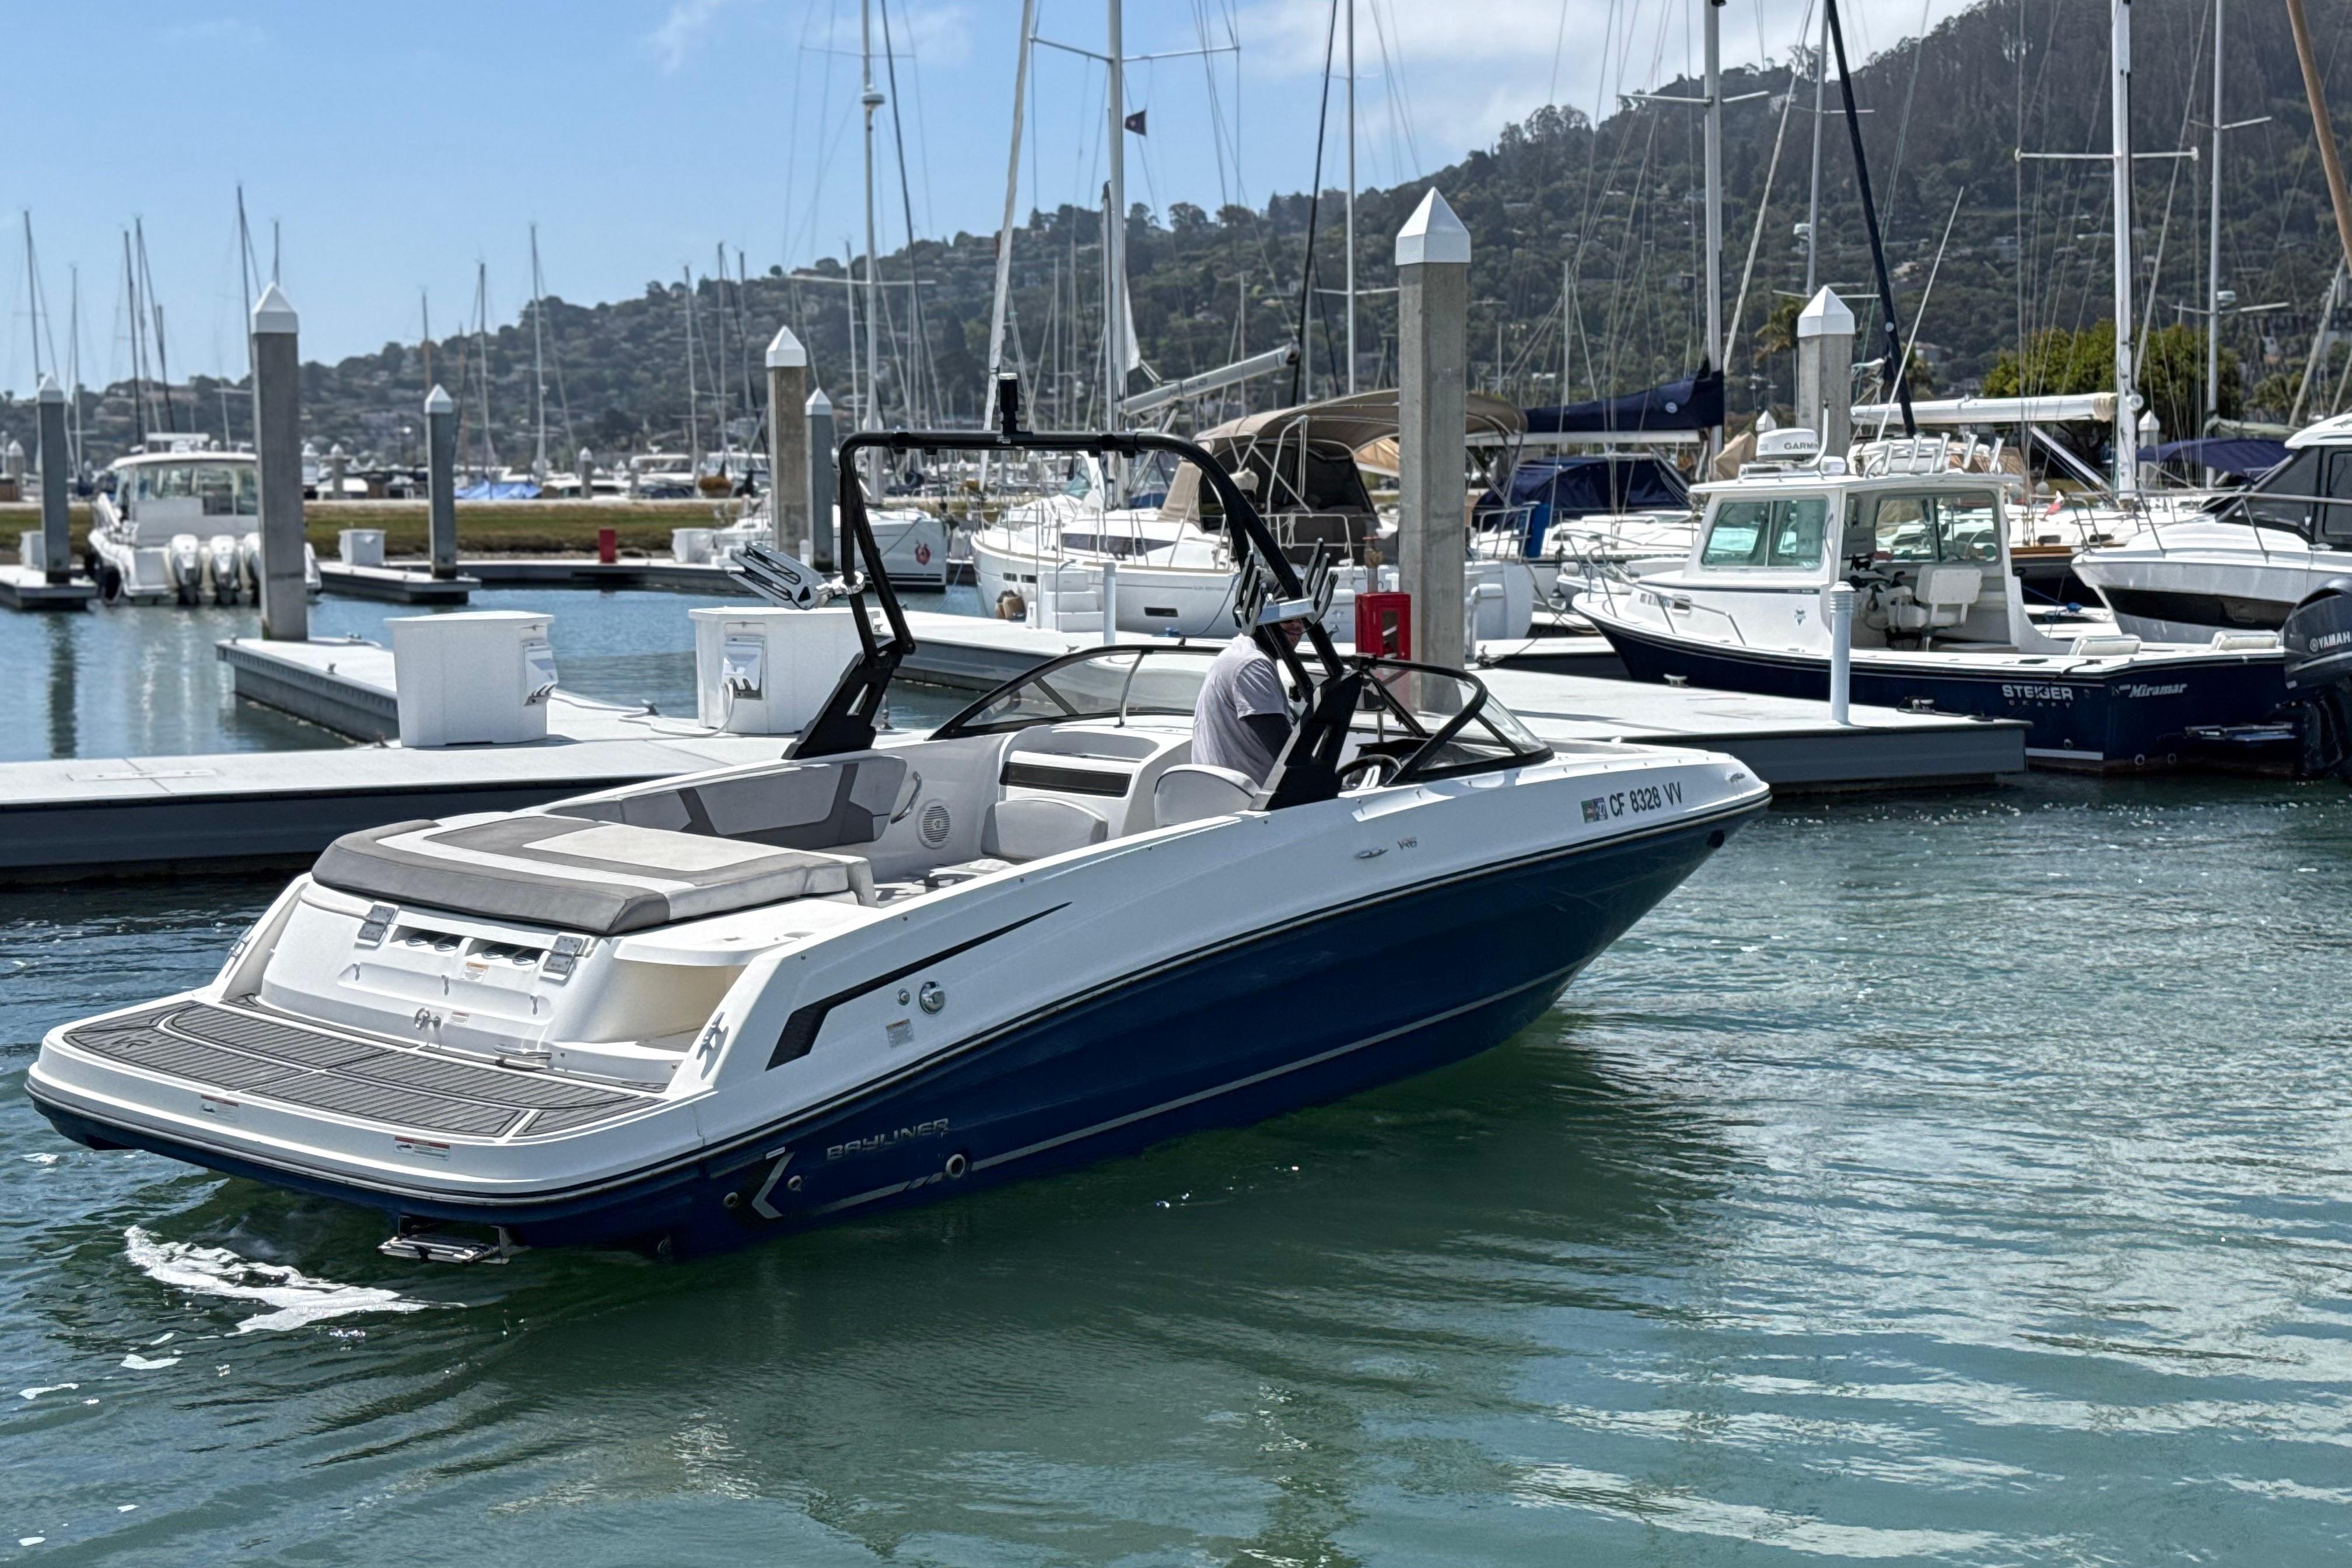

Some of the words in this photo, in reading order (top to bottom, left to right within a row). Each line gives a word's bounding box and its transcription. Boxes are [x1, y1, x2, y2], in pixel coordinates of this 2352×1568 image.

[2318, 631, 2352, 650] YAMAH
[2002, 684, 2073, 700] STEIGER
[2129, 684, 2188, 698] Miramar
[1609, 792, 1625, 817] CF
[1629, 786, 1662, 813] 8328
[1662, 781, 1682, 806] VV
[827, 1118, 950, 1160] BAYLINER
